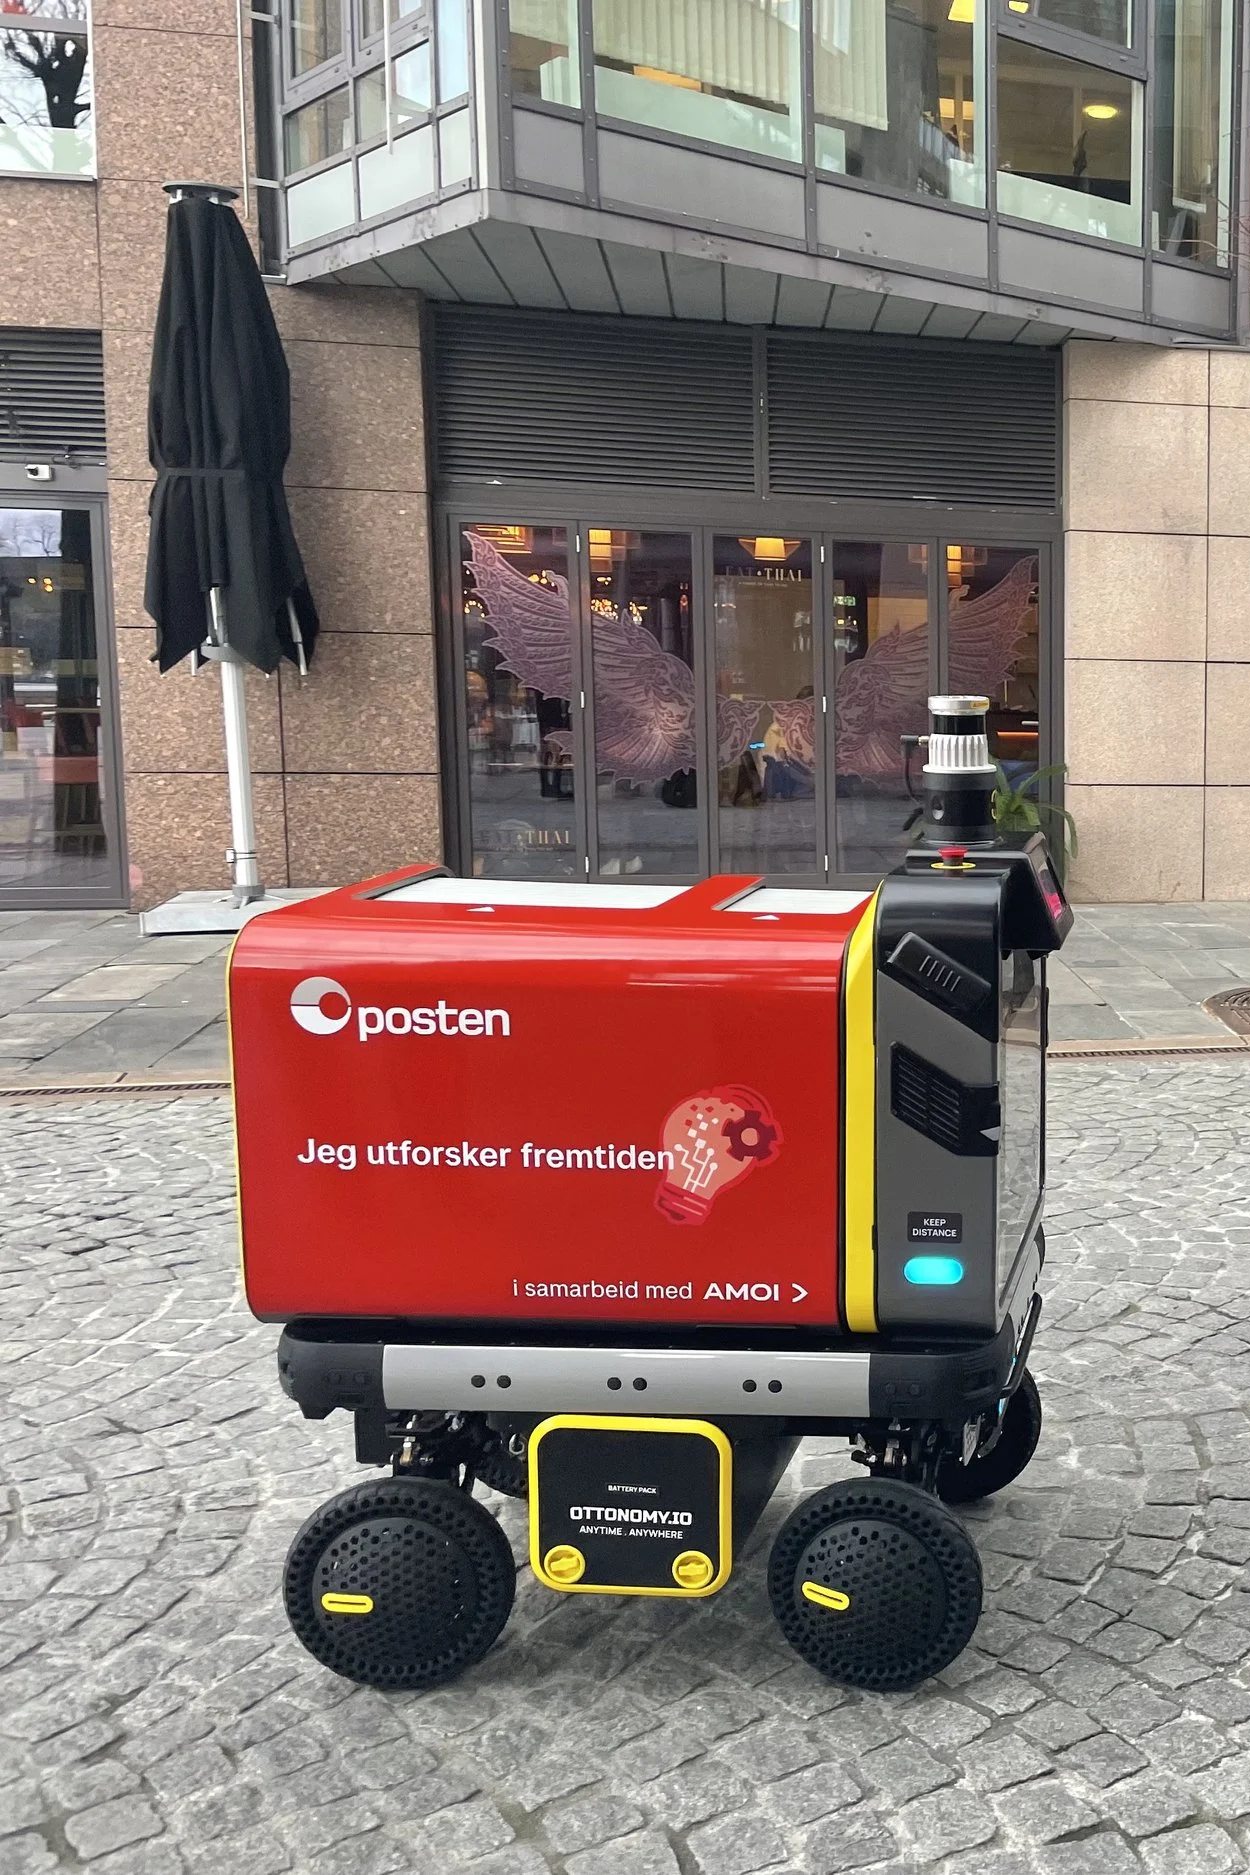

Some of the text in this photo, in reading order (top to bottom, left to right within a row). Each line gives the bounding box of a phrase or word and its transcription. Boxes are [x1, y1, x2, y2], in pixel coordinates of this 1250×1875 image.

[357, 1000, 511, 1041] posten
[297, 1138, 674, 1170] Jeg utforsker fremtiden
[923, 1218, 946, 1227] KEEP
[912, 1228, 957, 1237] DISTANCE
[513, 1279, 780, 1301] i samarbeid med AMOI
[608, 1485, 657, 1494] BATTERY PACK
[569, 1506, 693, 1526] OTTONOMY.IO
[579, 1525, 684, 1540] ANYTIME ANYWHERE
